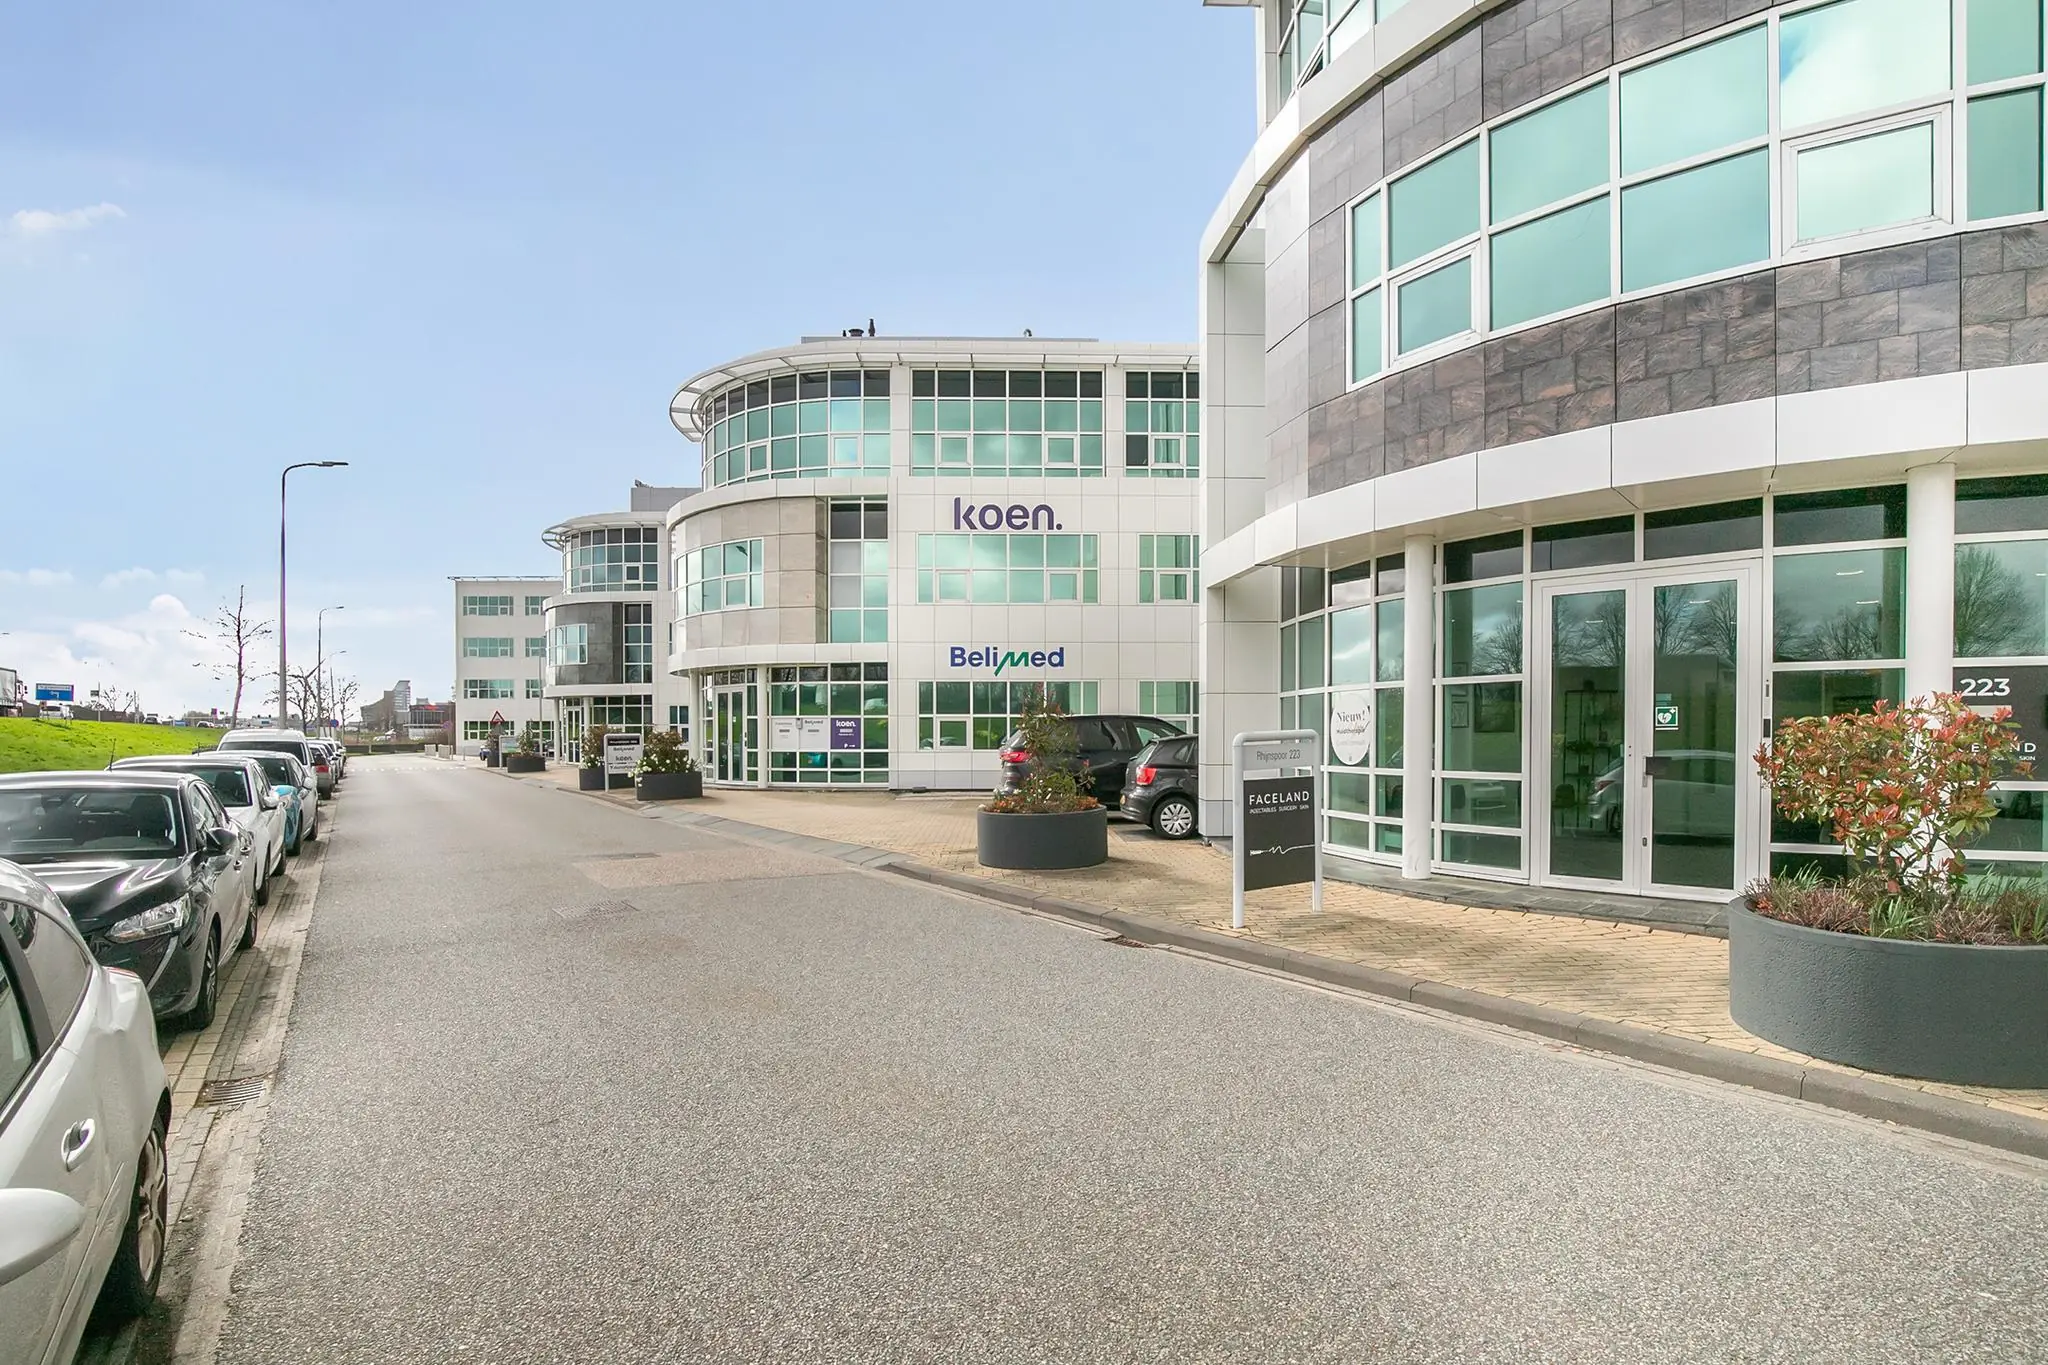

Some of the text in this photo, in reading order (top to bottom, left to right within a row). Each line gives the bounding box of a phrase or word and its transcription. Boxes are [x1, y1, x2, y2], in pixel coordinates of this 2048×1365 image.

[953, 496, 1063, 531] koen.
[1960, 678, 2011, 696] 223
[1289, 749, 1301, 760] 223
[1249, 790, 1310, 806] FACELAND
